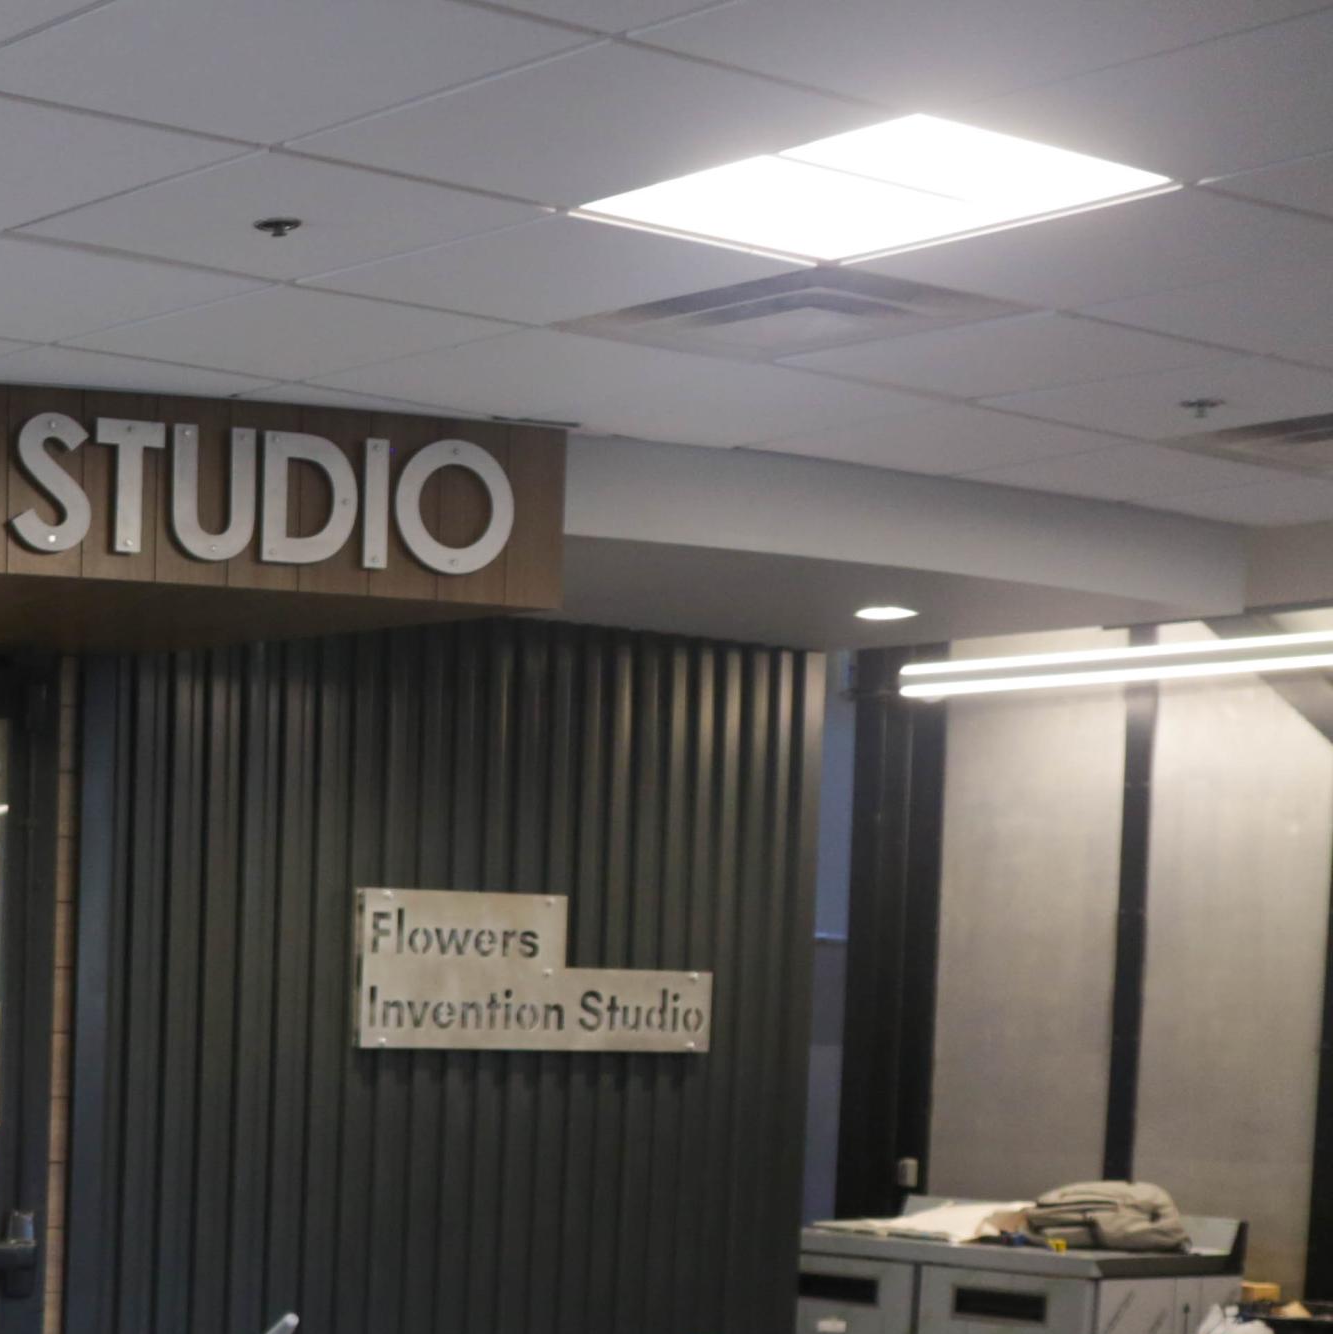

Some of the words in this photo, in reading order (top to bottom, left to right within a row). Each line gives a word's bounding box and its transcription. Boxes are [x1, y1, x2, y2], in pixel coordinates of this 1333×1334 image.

[10, 411, 514, 575] STUDIO
[370, 907, 540, 958] Flowers
[368, 985, 565, 1031] Invention
[578, 988, 705, 1033] Studio
